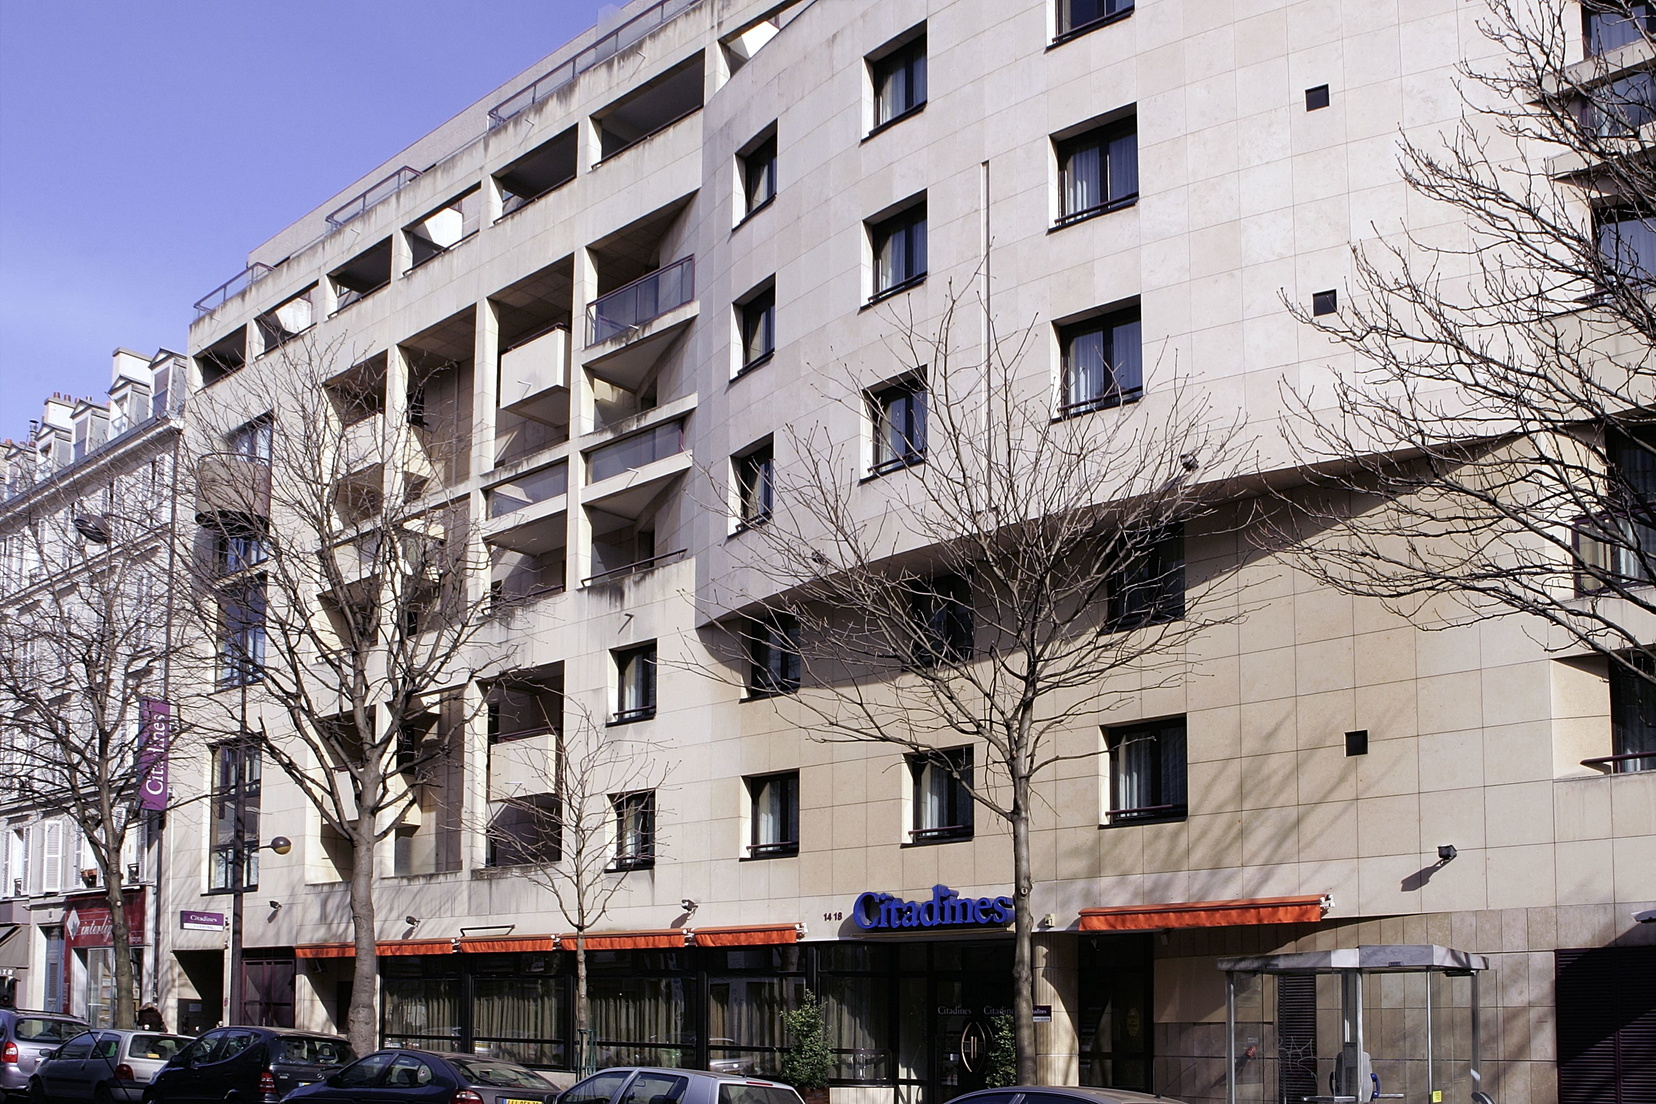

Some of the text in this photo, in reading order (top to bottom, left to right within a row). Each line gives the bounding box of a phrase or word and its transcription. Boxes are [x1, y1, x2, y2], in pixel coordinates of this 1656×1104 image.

[853, 884, 1014, 929] Citadines
[823, 911, 843, 921] 14 18
[937, 1005, 972, 1015] Citadines
[983, 1005, 1014, 1015] Citadin
